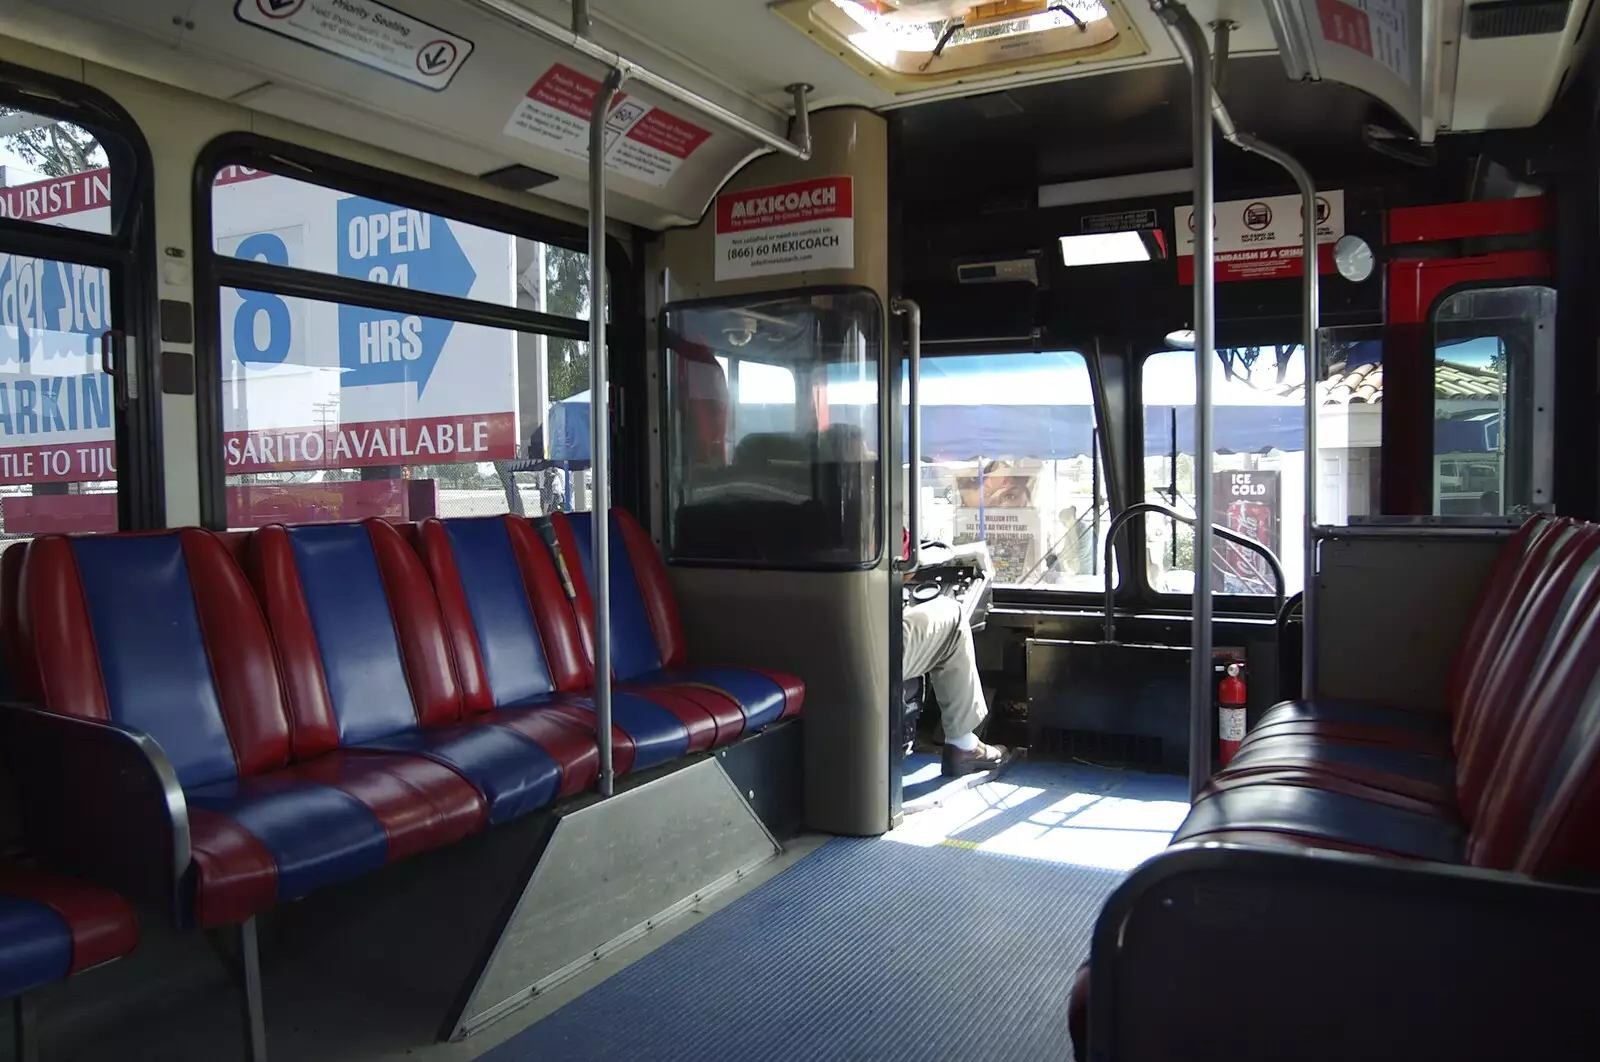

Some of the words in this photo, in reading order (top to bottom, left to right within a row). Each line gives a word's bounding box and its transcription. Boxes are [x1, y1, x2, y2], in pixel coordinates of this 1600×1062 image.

[373, 13, 411, 36] Seating
[0, 180, 76, 219] URIST
[84, 173, 111, 205] IN
[731, 187, 836, 219] MEXICOACH
[349, 208, 431, 259] OPEN
[728, 246, 754, 260] (866)
[756, 244, 770, 255] 60
[772, 235, 839, 253] MEXICOACH
[1214, 251, 1259, 262] ANDALISM
[1260, 250, 1268, 259] IS
[1270, 250, 1278, 258] A
[234, 233, 291, 371] 8
[359, 316, 422, 364] HRS
[223, 431, 324, 466] SARITO
[332, 421, 489, 459] AVAILABLE
[1, 453, 34, 477] TLE
[39, 449, 71, 476] TO
[1231, 473, 1252, 484] ICE
[1231, 484, 1266, 495] COLD
